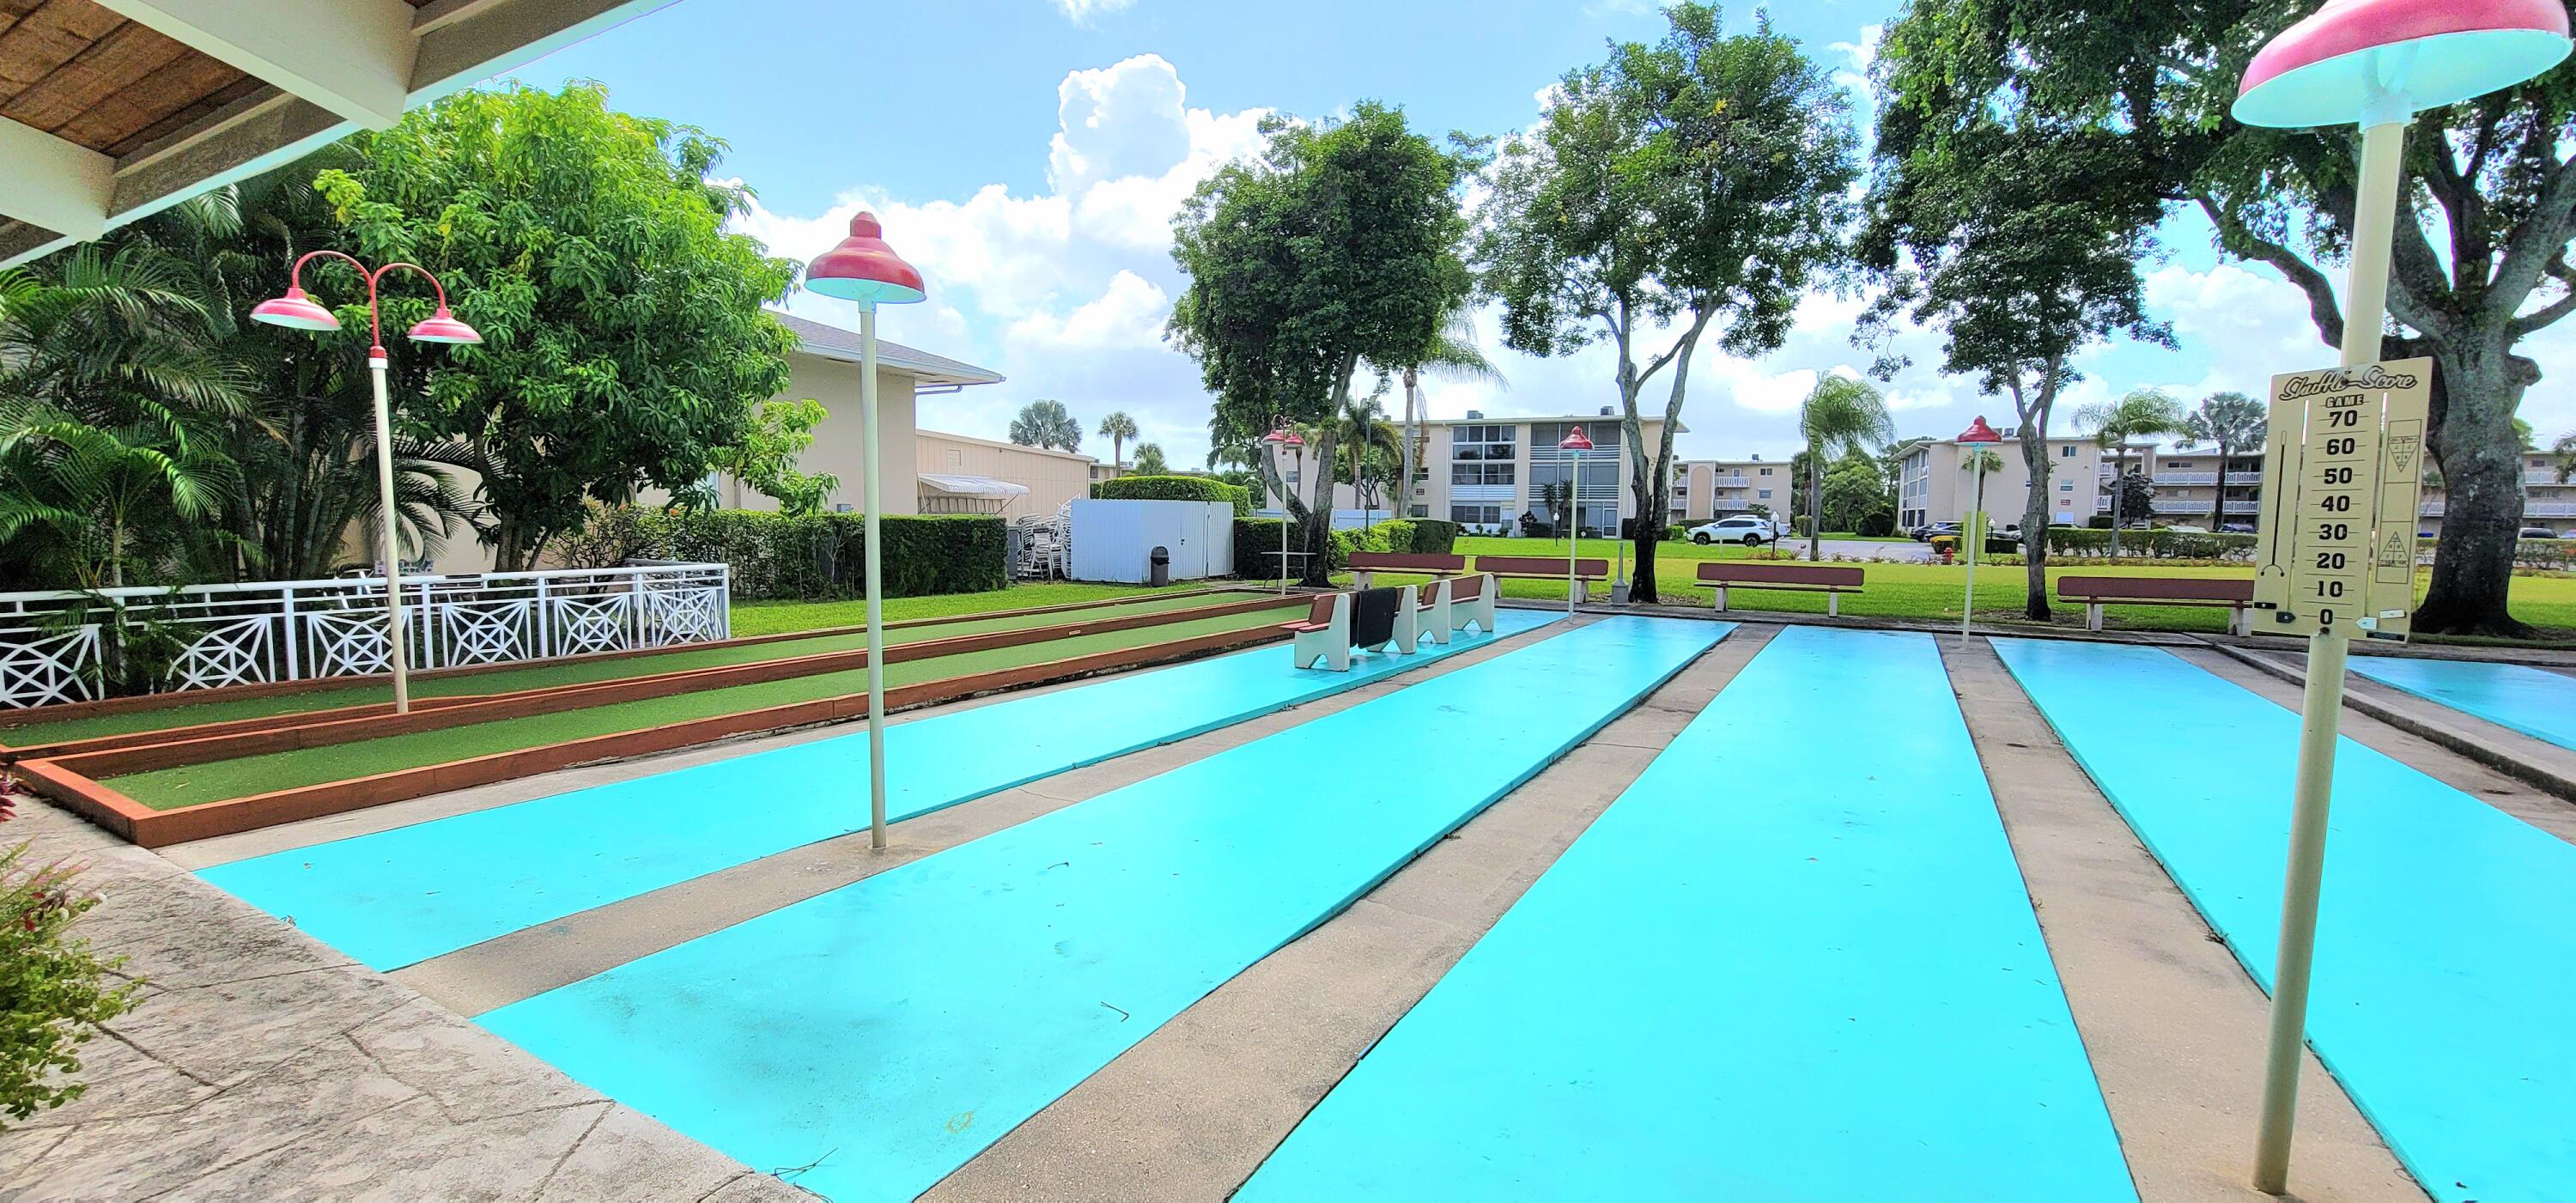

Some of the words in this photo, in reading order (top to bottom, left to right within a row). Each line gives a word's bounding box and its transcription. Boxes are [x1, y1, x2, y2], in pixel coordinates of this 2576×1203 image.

[2361, 365, 2418, 389] Score
[2325, 394, 2364, 408] GAME
[2329, 410, 2358, 428] 70
[2326, 438, 2355, 455] 60
[2324, 467, 2353, 484] 50
[2321, 495, 2350, 512] 40
[2318, 524, 2348, 540] 30
[2317, 553, 2345, 569] 20
[2318, 580, 2343, 598] 10
[2320, 609, 2333, 625] 0
